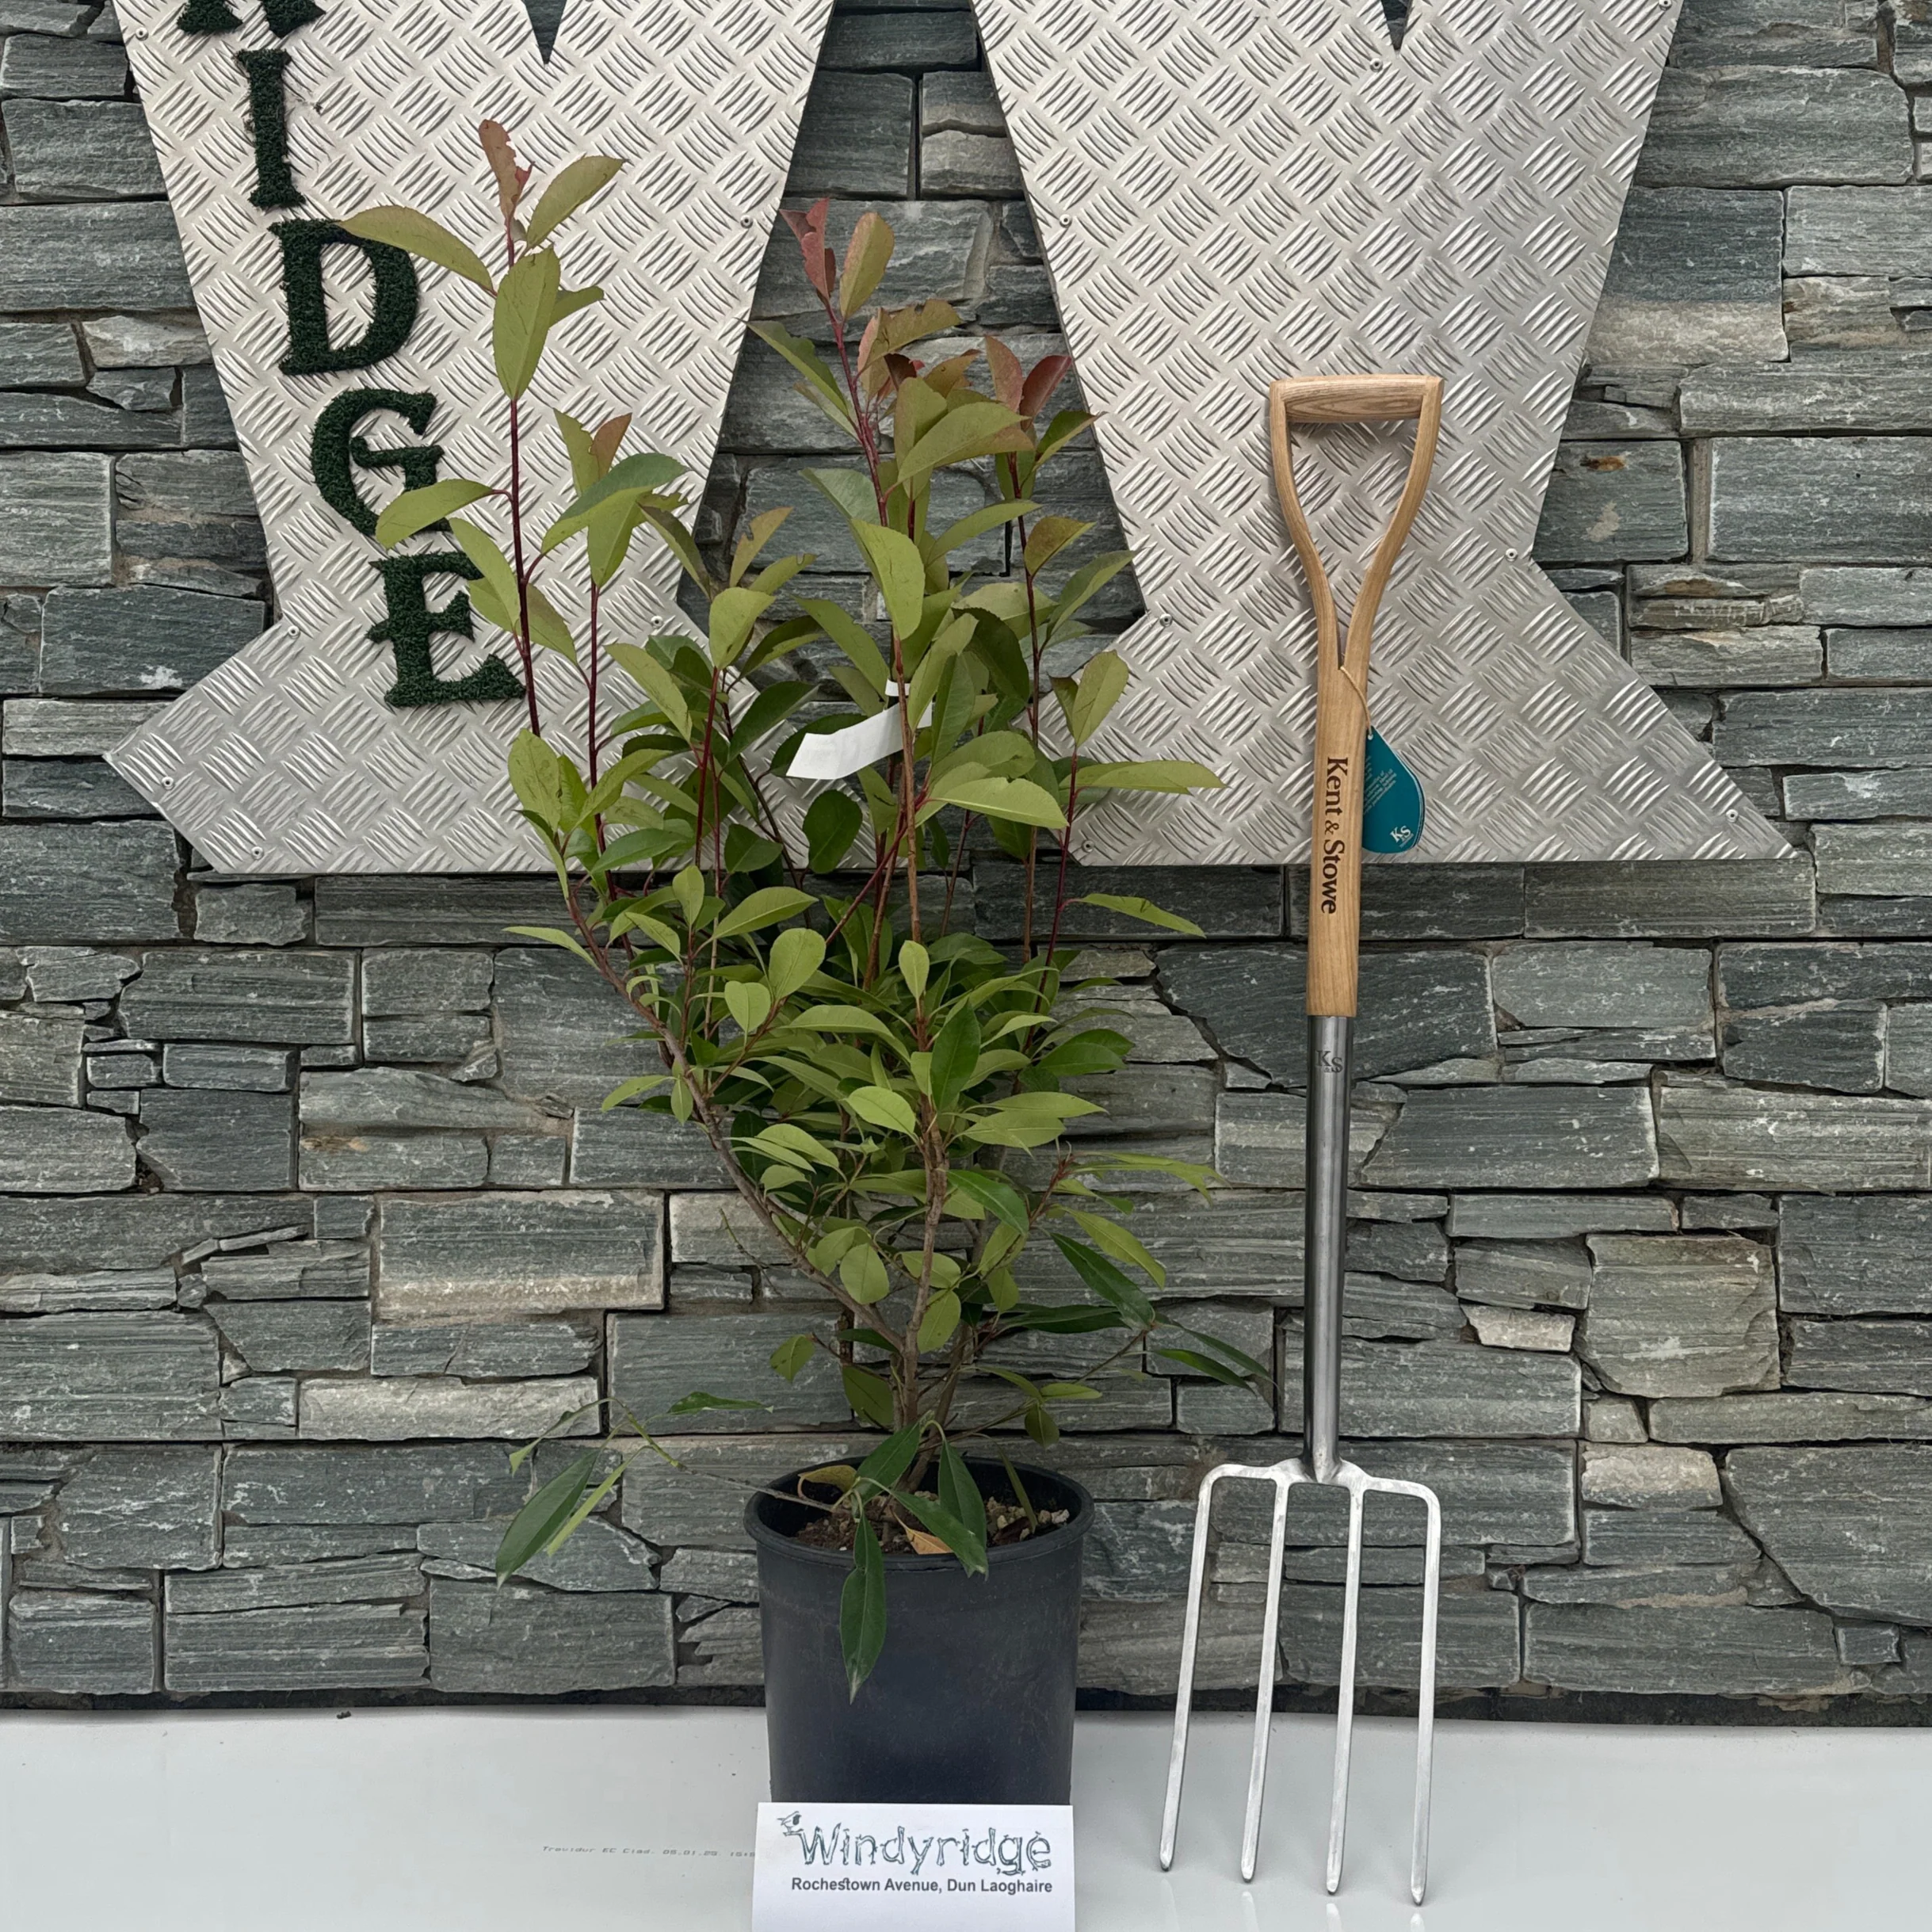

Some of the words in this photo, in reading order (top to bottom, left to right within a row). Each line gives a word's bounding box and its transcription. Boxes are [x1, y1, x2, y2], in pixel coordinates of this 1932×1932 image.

[177, 0, 526, 708] IDGE
[1325, 757, 1349, 816] Kent
[1324, 819, 1340, 835] &
[1321, 839, 1346, 914] Stowe
[792, 1822, 1052, 1877] Windyridge
[792, 1877, 880, 1892] Rochestown
[884, 1878, 943, 1894] Avenue,
[947, 1878, 976, 1893] Dun
[980, 1879, 1053, 1896] Laoghaire
